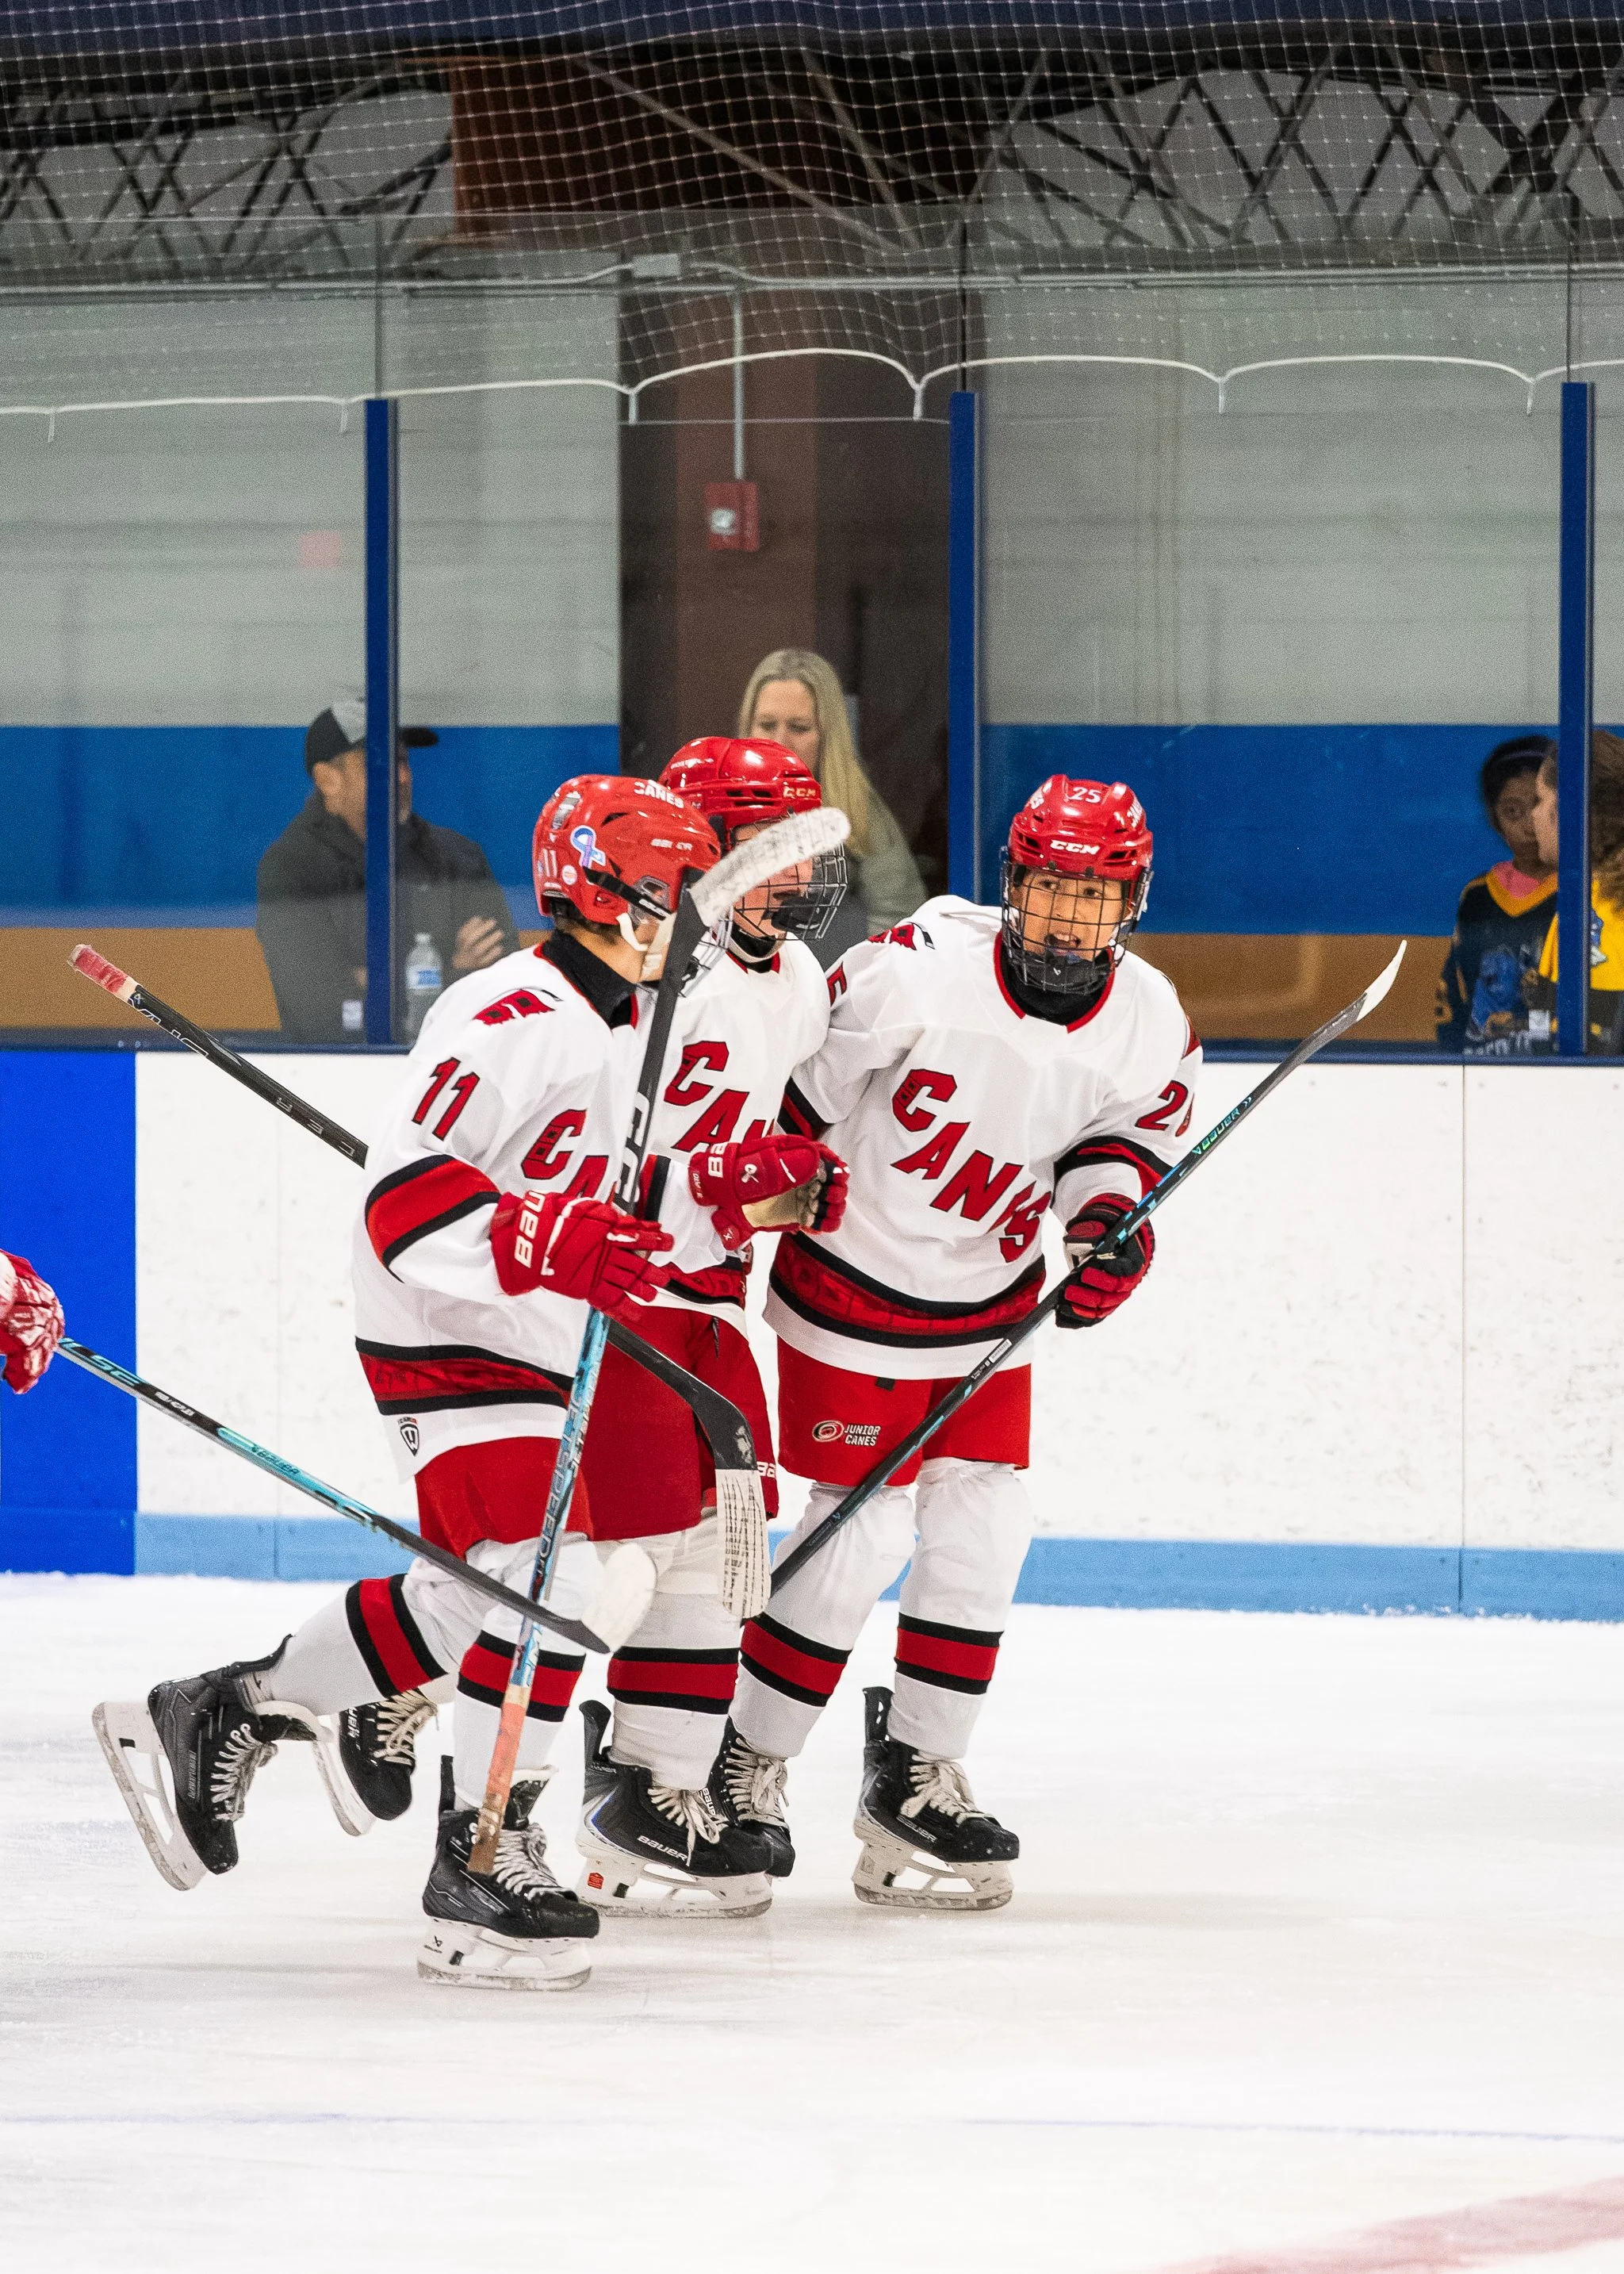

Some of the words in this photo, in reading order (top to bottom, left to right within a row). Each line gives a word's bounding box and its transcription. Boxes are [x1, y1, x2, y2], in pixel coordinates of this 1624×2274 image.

[1069, 786, 1102, 803] 25
[1050, 839, 1101, 855] CCM
[412, 1056, 481, 1141] 11
[1135, 1079, 1195, 1137] 2
[514, 1190, 547, 1269] BAU
[844, 1424, 881, 1436] JUNIOR
[845, 1434, 877, 1447] CANES
[702, 1787, 716, 1816] BAUE
[637, 1835, 688, 1862] BAUER
